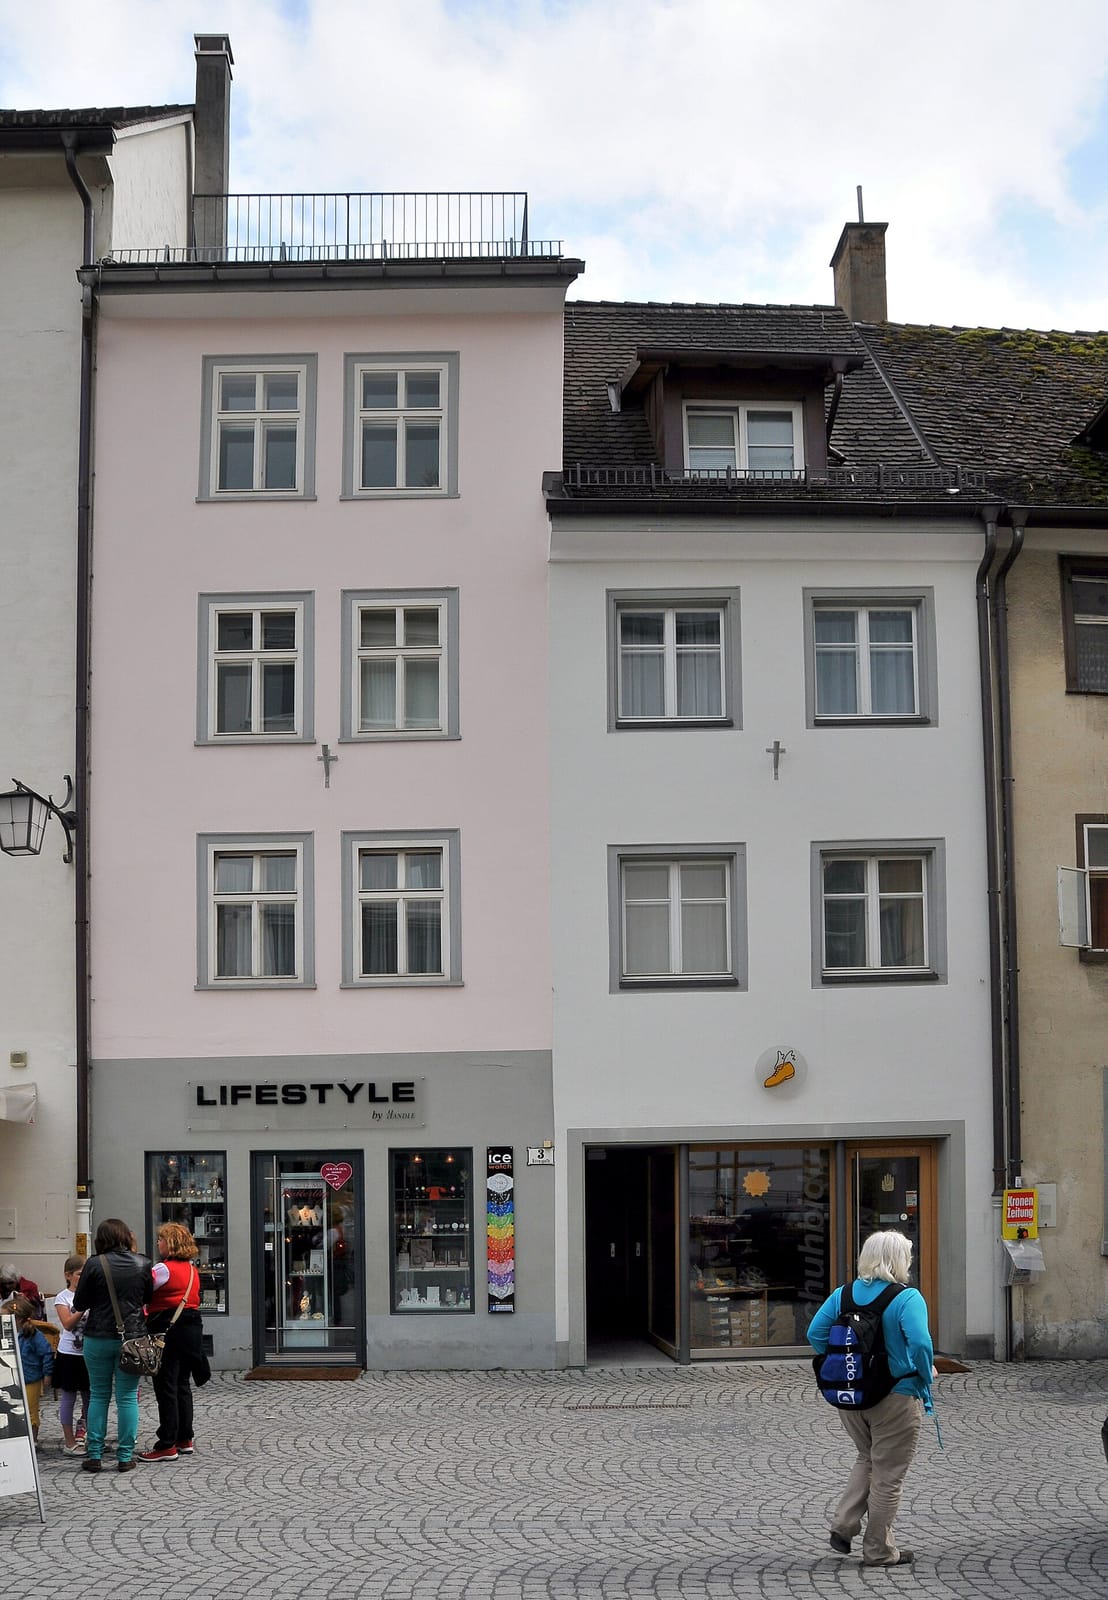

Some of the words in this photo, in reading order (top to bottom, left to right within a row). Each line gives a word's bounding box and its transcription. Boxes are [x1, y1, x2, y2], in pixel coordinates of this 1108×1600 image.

[197, 1081, 415, 1106] LIFESTYLE
[372, 1110, 383, 1122] by
[488, 1150, 512, 1163] ice
[537, 1149, 545, 1159] 3
[1007, 1196, 1034, 1207] Kronen
[1007, 1207, 1034, 1219] Zeitung
